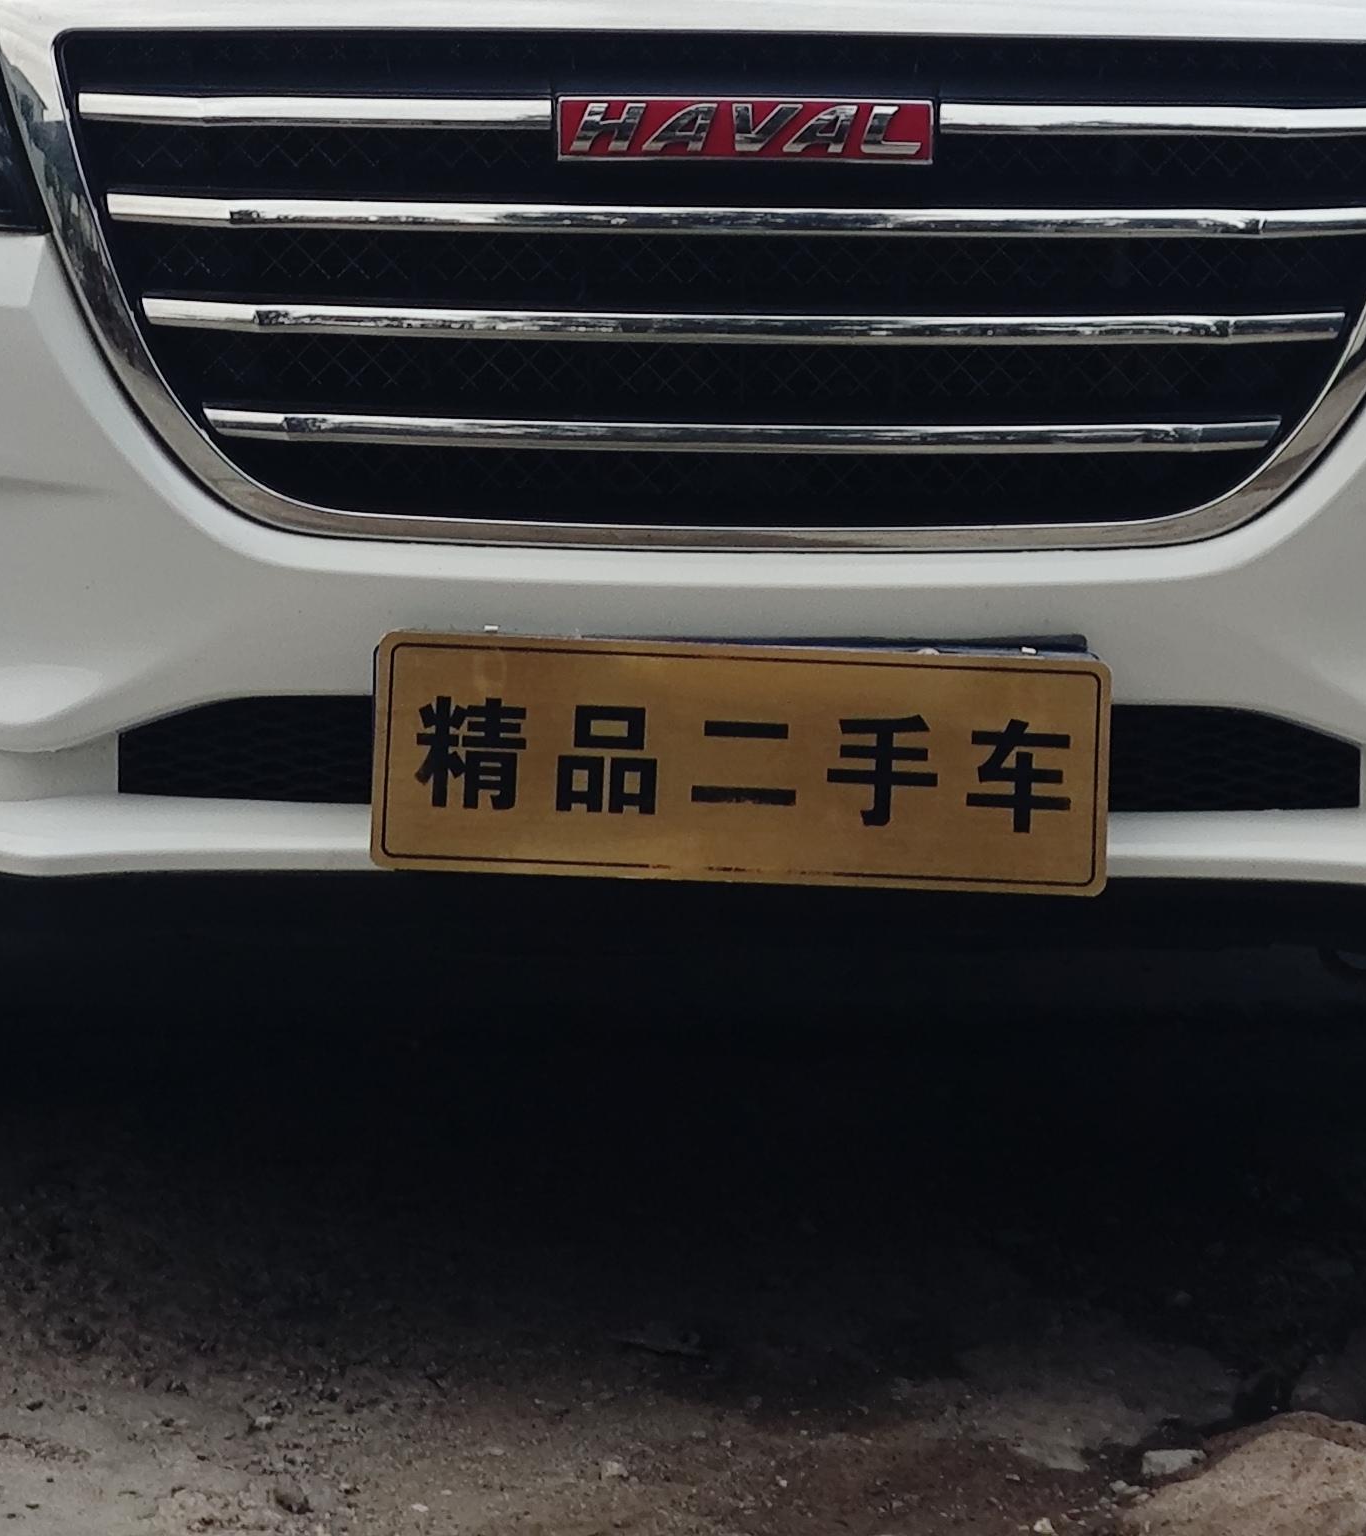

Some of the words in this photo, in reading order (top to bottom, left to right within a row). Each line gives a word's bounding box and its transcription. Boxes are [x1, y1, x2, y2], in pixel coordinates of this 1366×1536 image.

[570, 102, 922, 155] HAVAL
[415, 695, 1072, 834] 精品二手车
